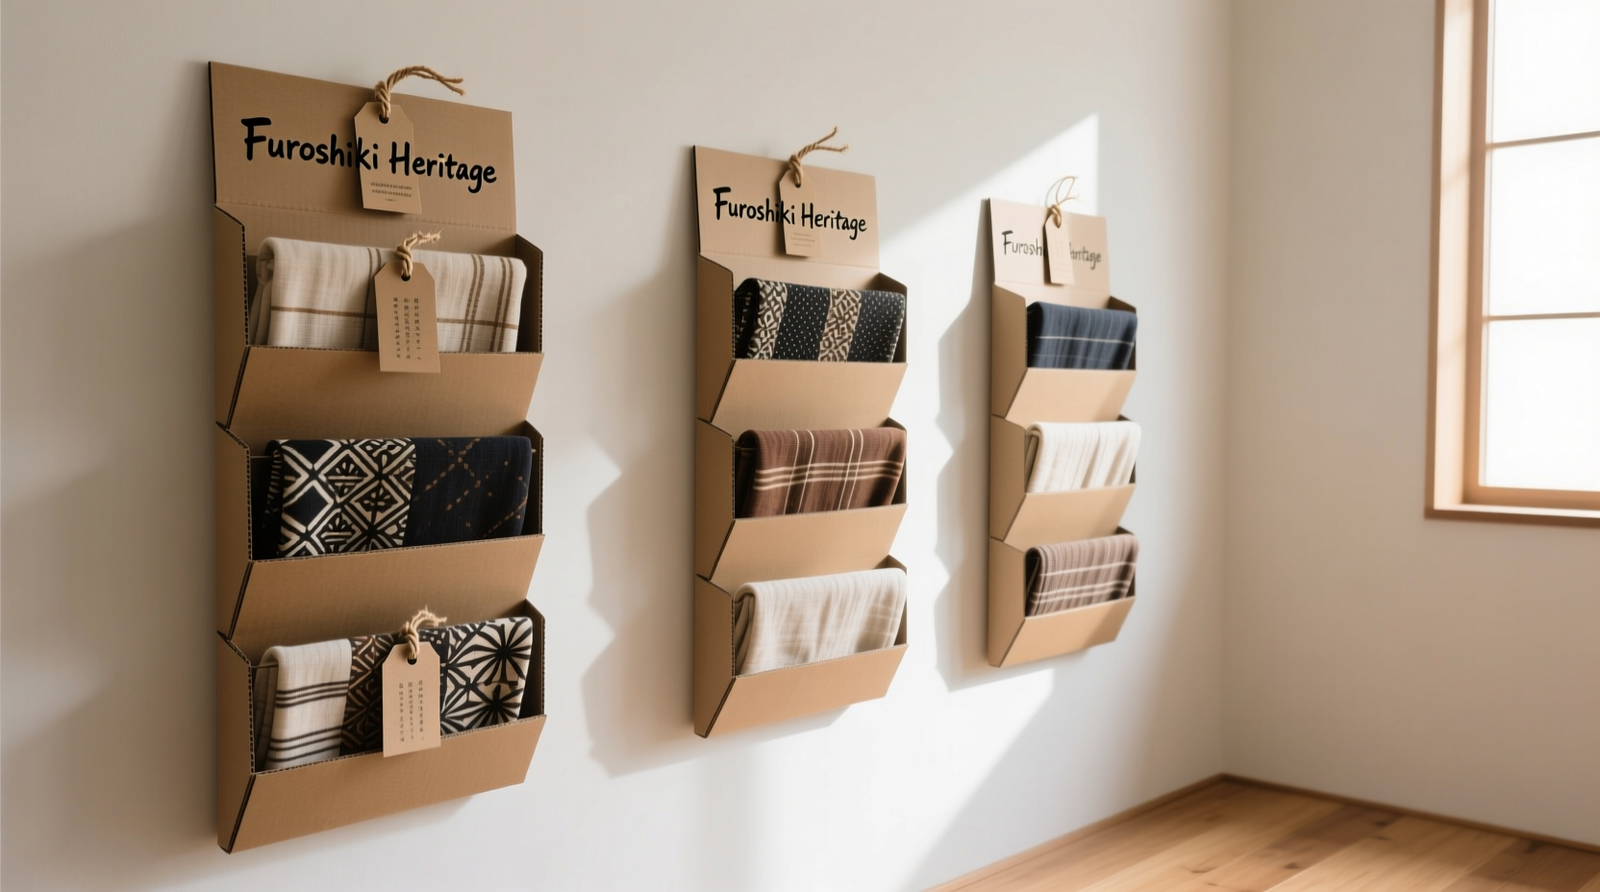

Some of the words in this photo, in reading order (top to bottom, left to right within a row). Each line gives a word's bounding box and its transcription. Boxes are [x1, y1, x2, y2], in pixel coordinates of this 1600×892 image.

[240, 117, 379, 170] Furoshiki
[389, 141, 497, 194] Heritage
[713, 186, 795, 225] Furoshiki
[801, 202, 867, 240] Heritage
